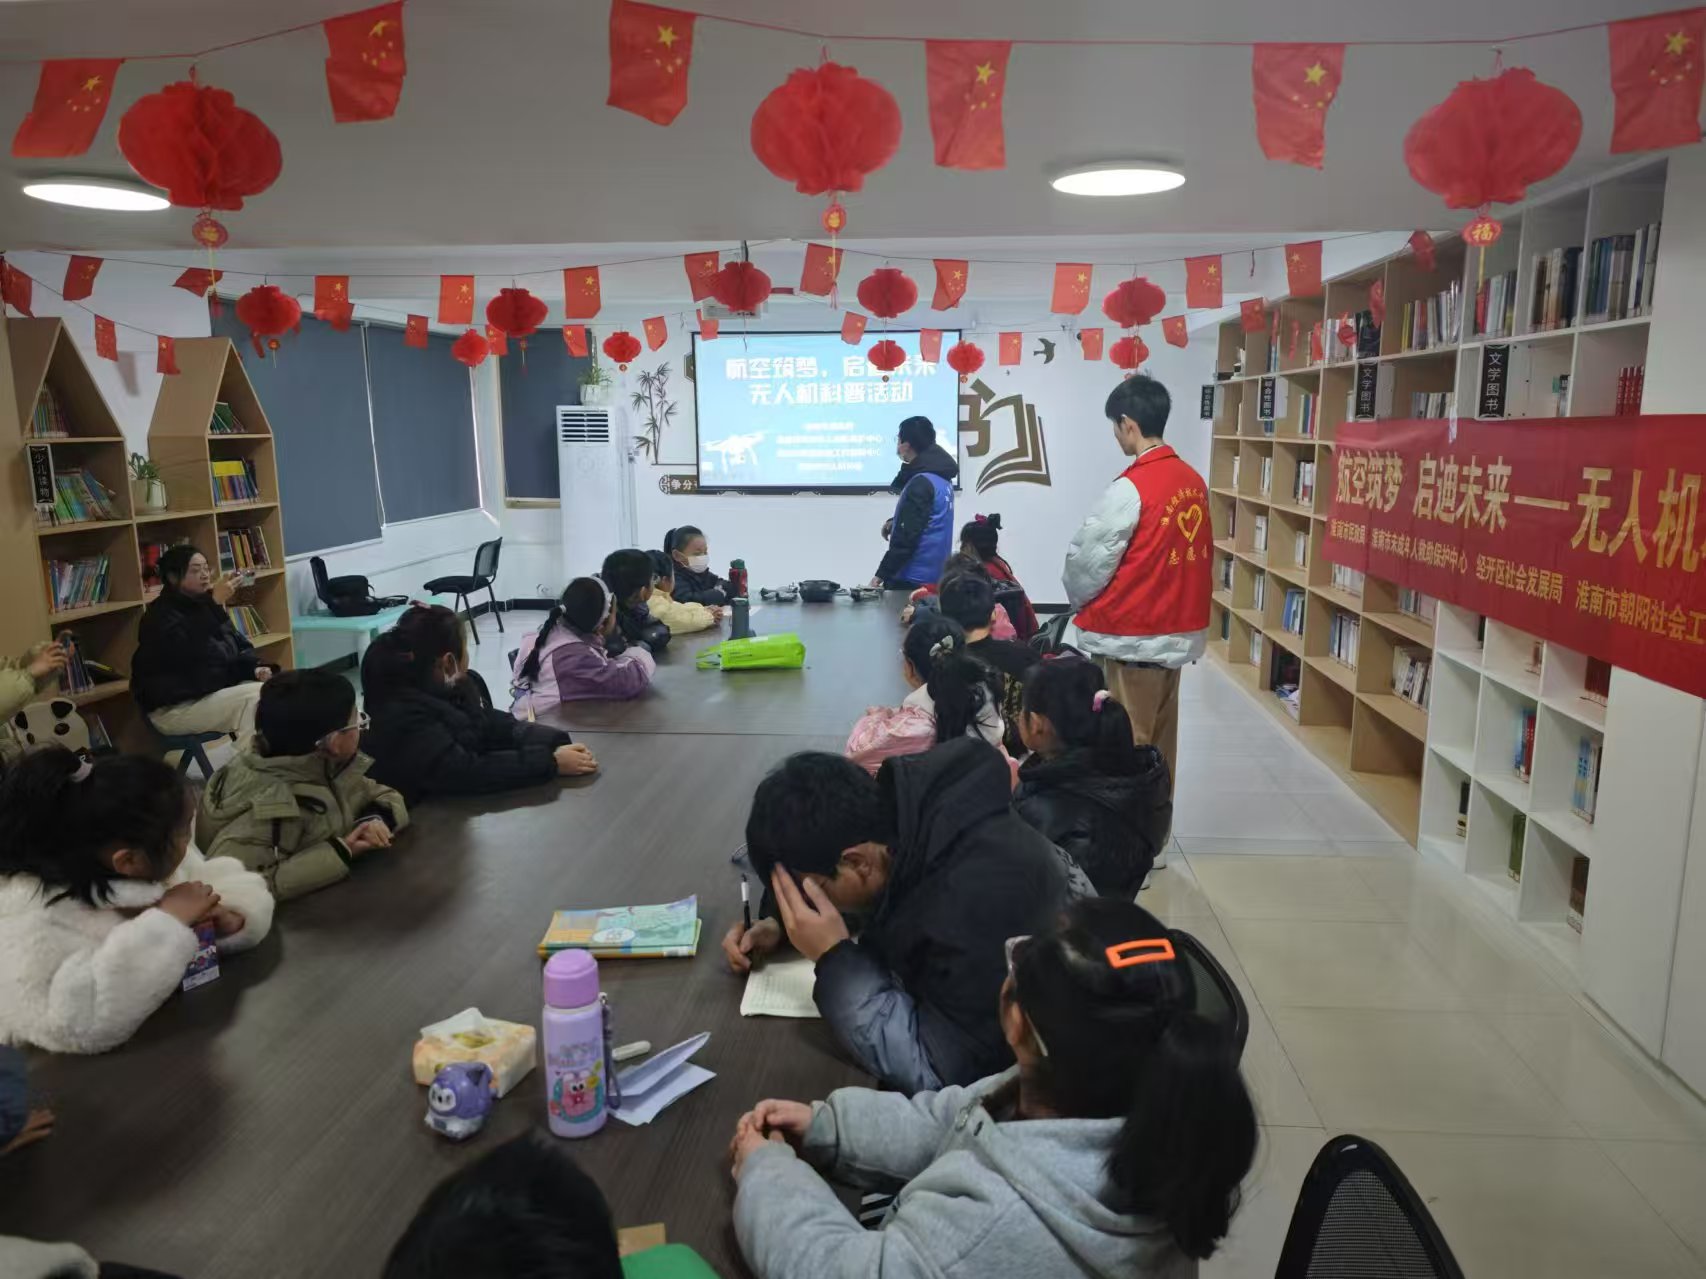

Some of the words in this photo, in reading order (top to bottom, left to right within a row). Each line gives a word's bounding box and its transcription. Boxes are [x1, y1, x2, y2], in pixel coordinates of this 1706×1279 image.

[1360, 367, 1373, 413] 文学图书
[1485, 352, 1502, 412] 文学图书
[1336, 450, 1403, 513] 航空筑梦
[1475, 552, 1563, 605] 经开区社会发展局
